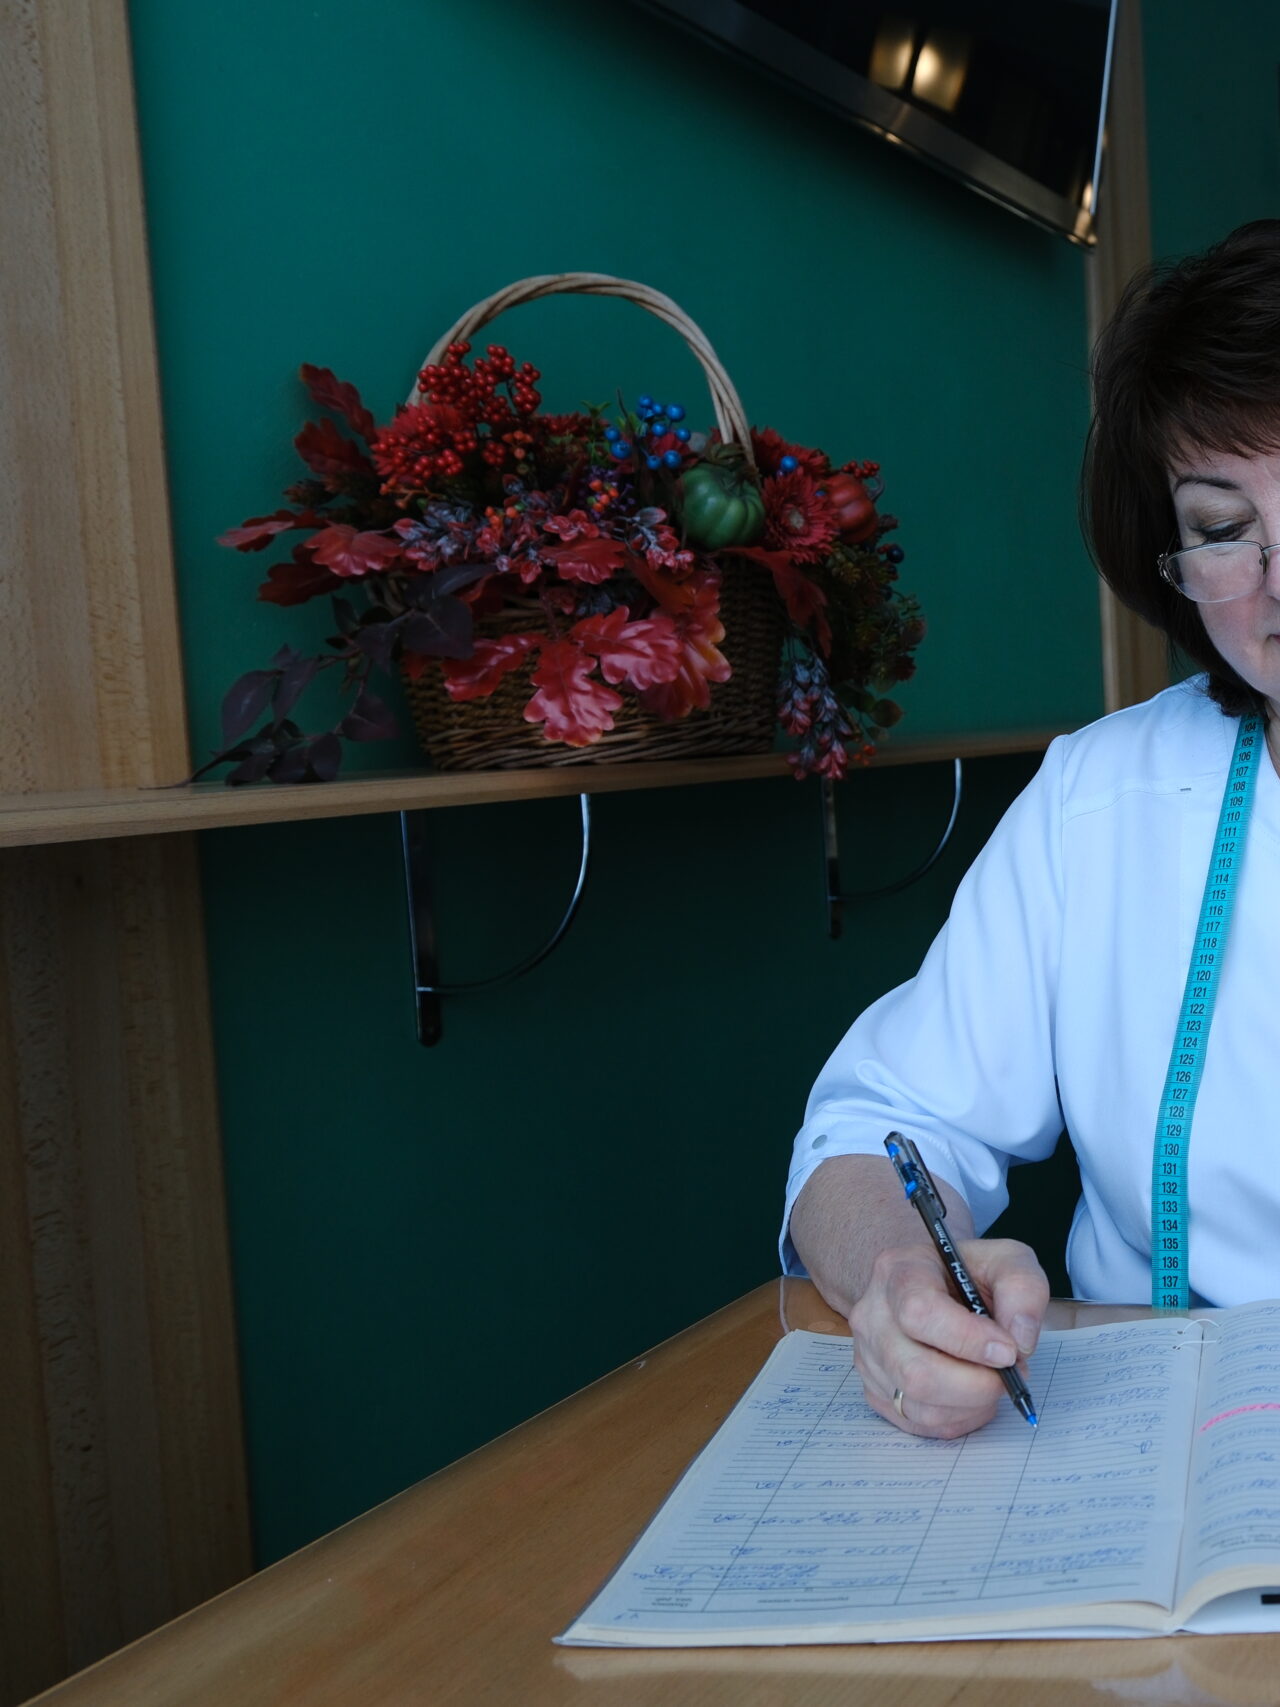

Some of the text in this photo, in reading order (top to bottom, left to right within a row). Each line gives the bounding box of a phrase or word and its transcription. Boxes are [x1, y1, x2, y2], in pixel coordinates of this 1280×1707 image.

[1241, 737, 1254, 747] 105
[1238, 751, 1251, 762] 106
[1235, 766, 1249, 777] 107
[1233, 781, 1246, 791] 108
[1230, 796, 1243, 807] 109
[1227, 811, 1240, 822] 110
[1224, 827, 1237, 837] 111
[1221, 842, 1235, 852] 112
[1218, 858, 1232, 868] 113
[1215, 873, 1229, 884] 114
[1212, 889, 1227, 900] 115
[1209, 905, 1223, 916] 116
[1206, 921, 1221, 932] 117
[1203, 937, 1218, 948] 118
[1199, 954, 1215, 965] 119
[1196, 970, 1211, 981] 120
[1193, 987, 1207, 998] 121
[1190, 1003, 1205, 1015] 122
[1186, 1020, 1202, 1031] 123
[1182, 1036, 1198, 1048] 124
[1179, 1053, 1195, 1065] 125
[1175, 1070, 1192, 1082] 126
[1172, 1088, 1188, 1100] 127
[1169, 1105, 1185, 1118] 128
[1166, 1124, 1182, 1137] 129
[1164, 1143, 1180, 1156] 130
[1162, 1162, 1177, 1175] 131
[1162, 1181, 1178, 1194] 132
[1162, 1200, 1178, 1213] 133
[1162, 1219, 1178, 1232] 134
[1162, 1238, 1179, 1250] 135
[1162, 1256, 1179, 1269] 136
[1162, 1275, 1179, 1288] 137
[1162, 1294, 1179, 1308] 138
